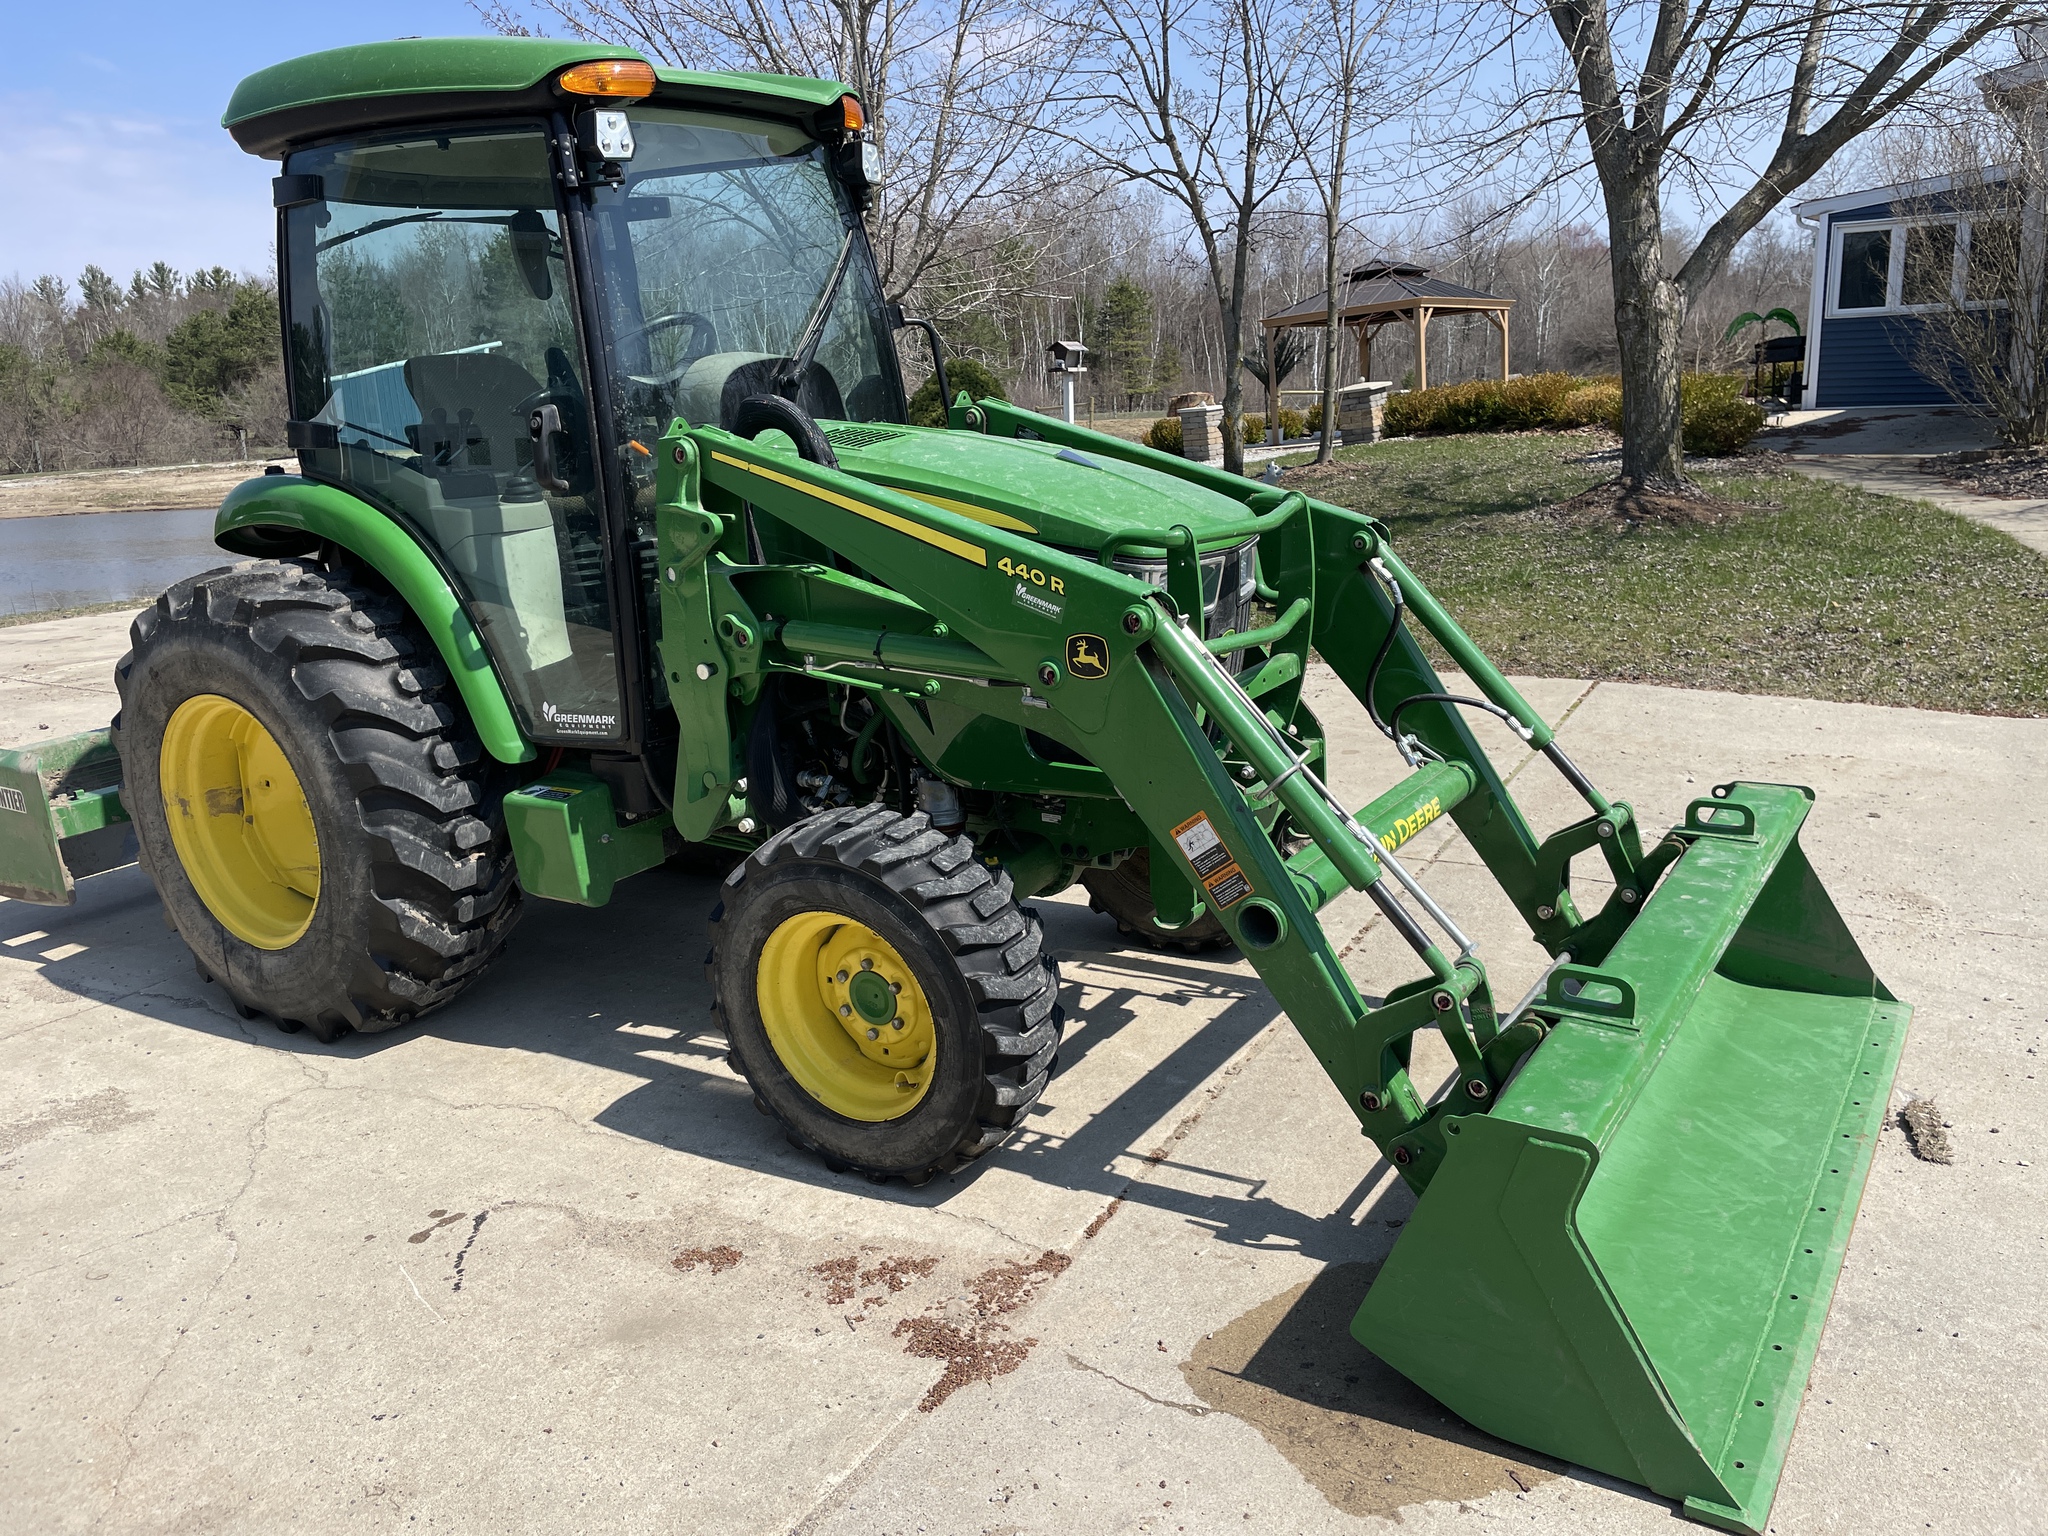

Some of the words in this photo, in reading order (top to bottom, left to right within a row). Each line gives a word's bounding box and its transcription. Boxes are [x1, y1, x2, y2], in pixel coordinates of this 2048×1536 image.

[997, 556, 1046, 586] 440
[1021, 592, 1061, 613] GREENMARK
[554, 713, 616, 725] GREENMARK
[559, 722, 612, 730] EQUIPMENT
[1180, 814, 1202, 832] WARNING
[1393, 796, 1441, 845] DEERE
[1213, 867, 1237, 884] WARNING
